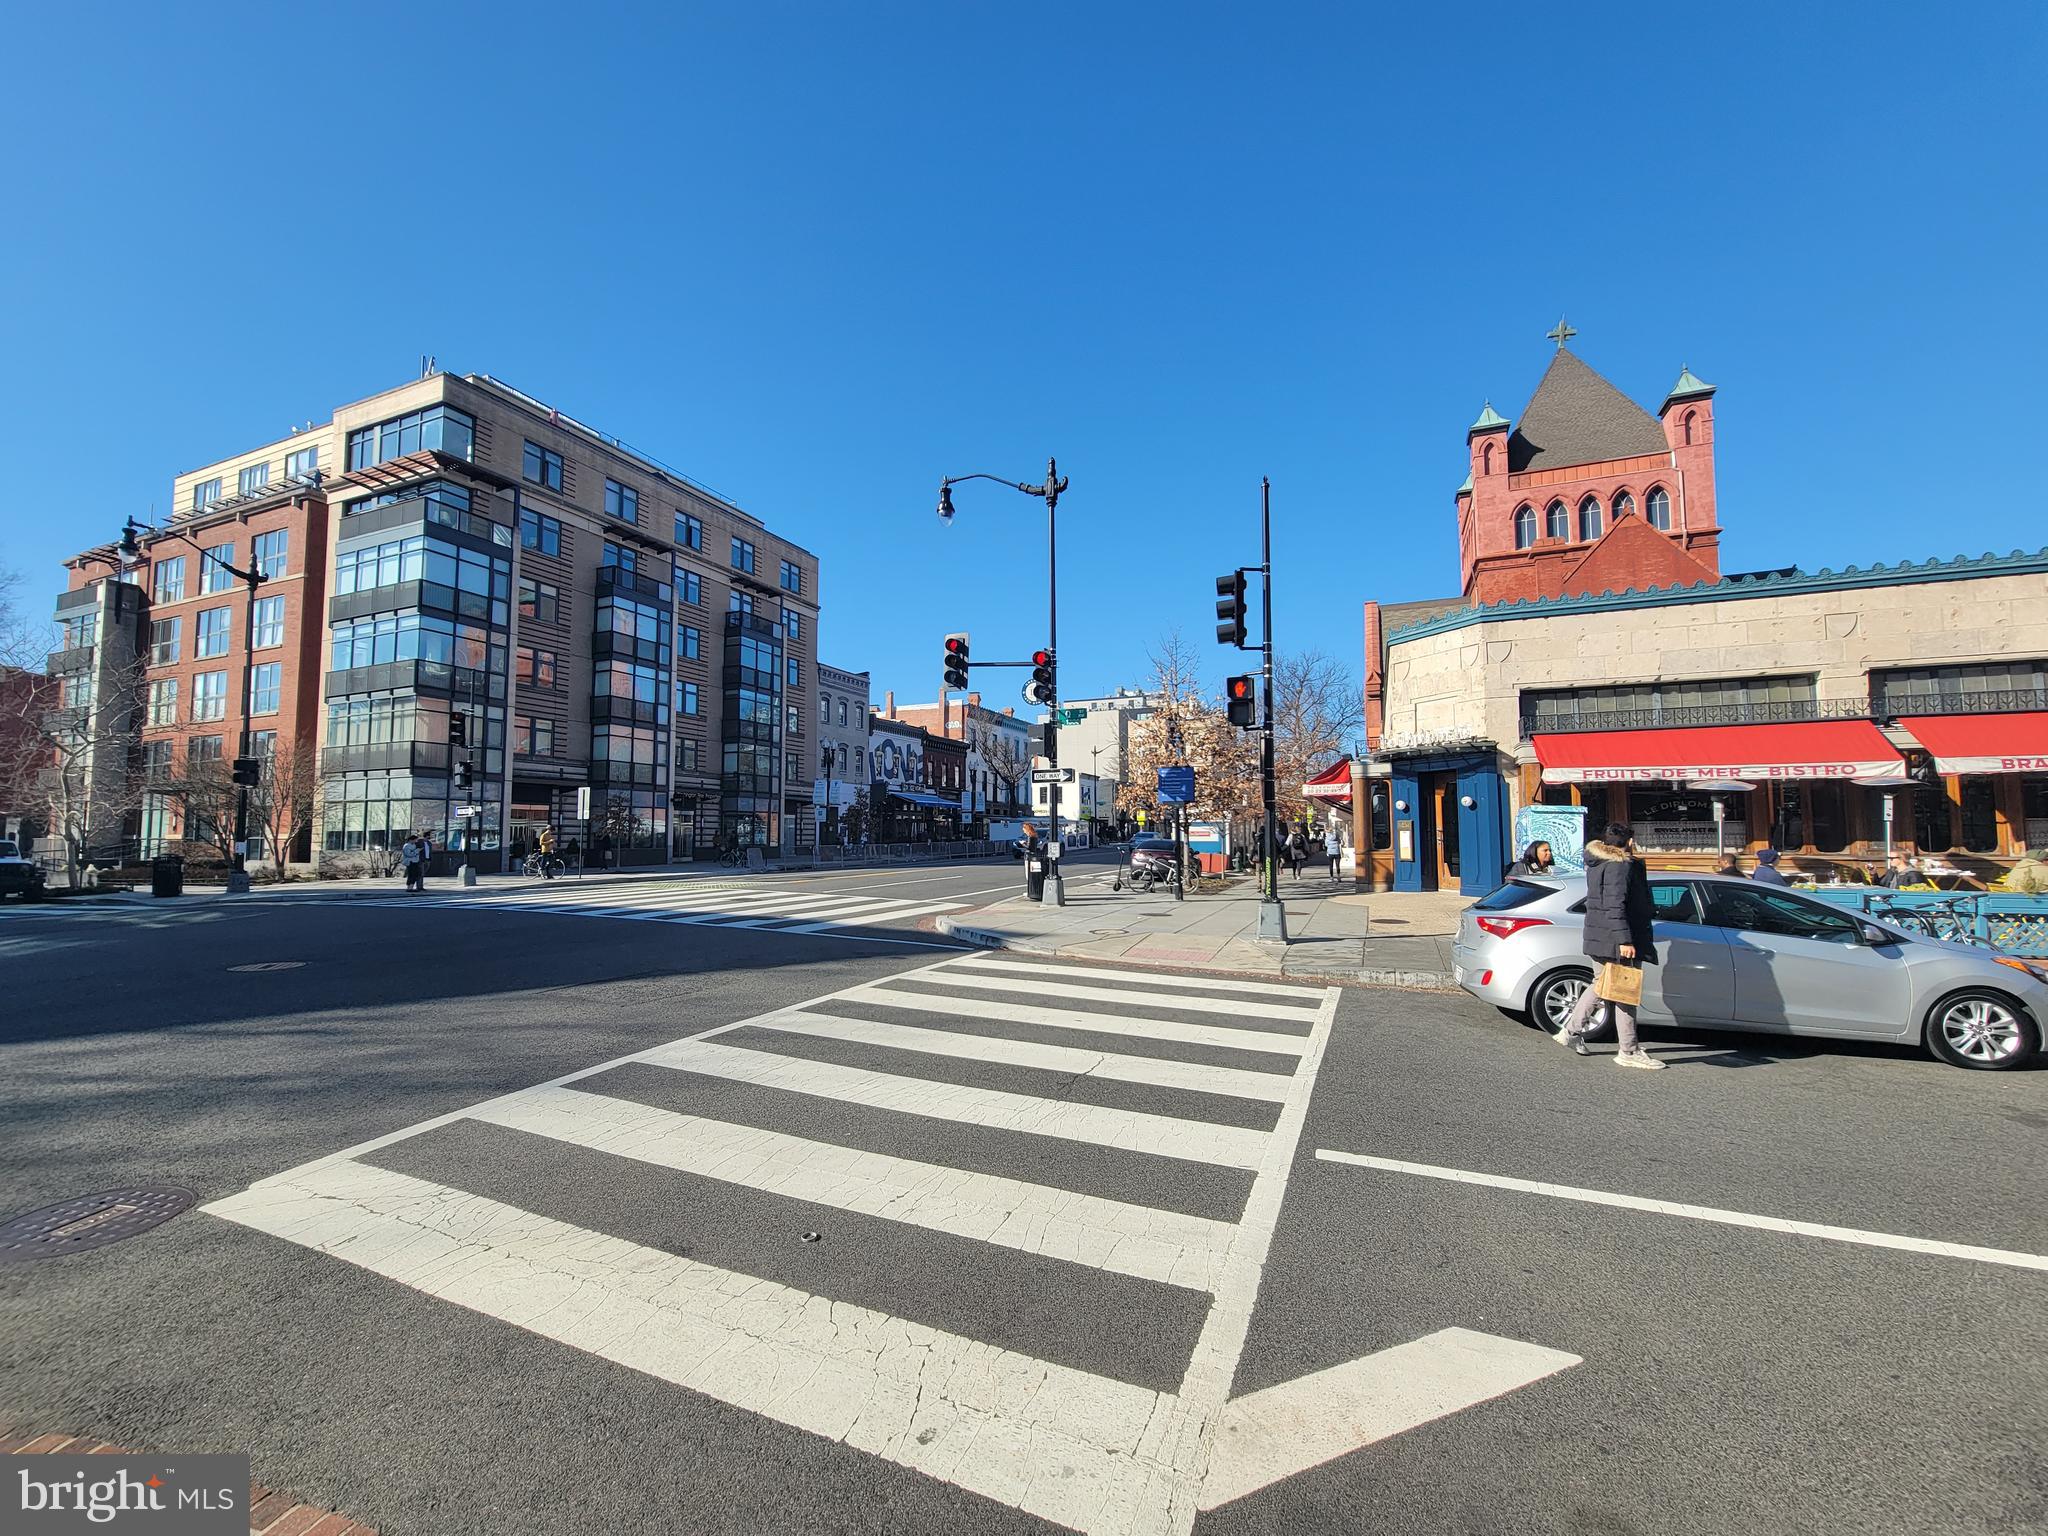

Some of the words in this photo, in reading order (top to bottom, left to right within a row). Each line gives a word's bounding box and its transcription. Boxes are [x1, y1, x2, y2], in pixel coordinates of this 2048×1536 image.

[2001, 758, 2048, 769] BRA
[1035, 772, 1047, 780] ONE
[1582, 768, 1651, 779] FRUITS
[1661, 768, 1688, 778] DE
[1698, 767, 1741, 777] MER
[1768, 764, 1857, 776] BISTRO
[1643, 805, 1659, 816] LE
